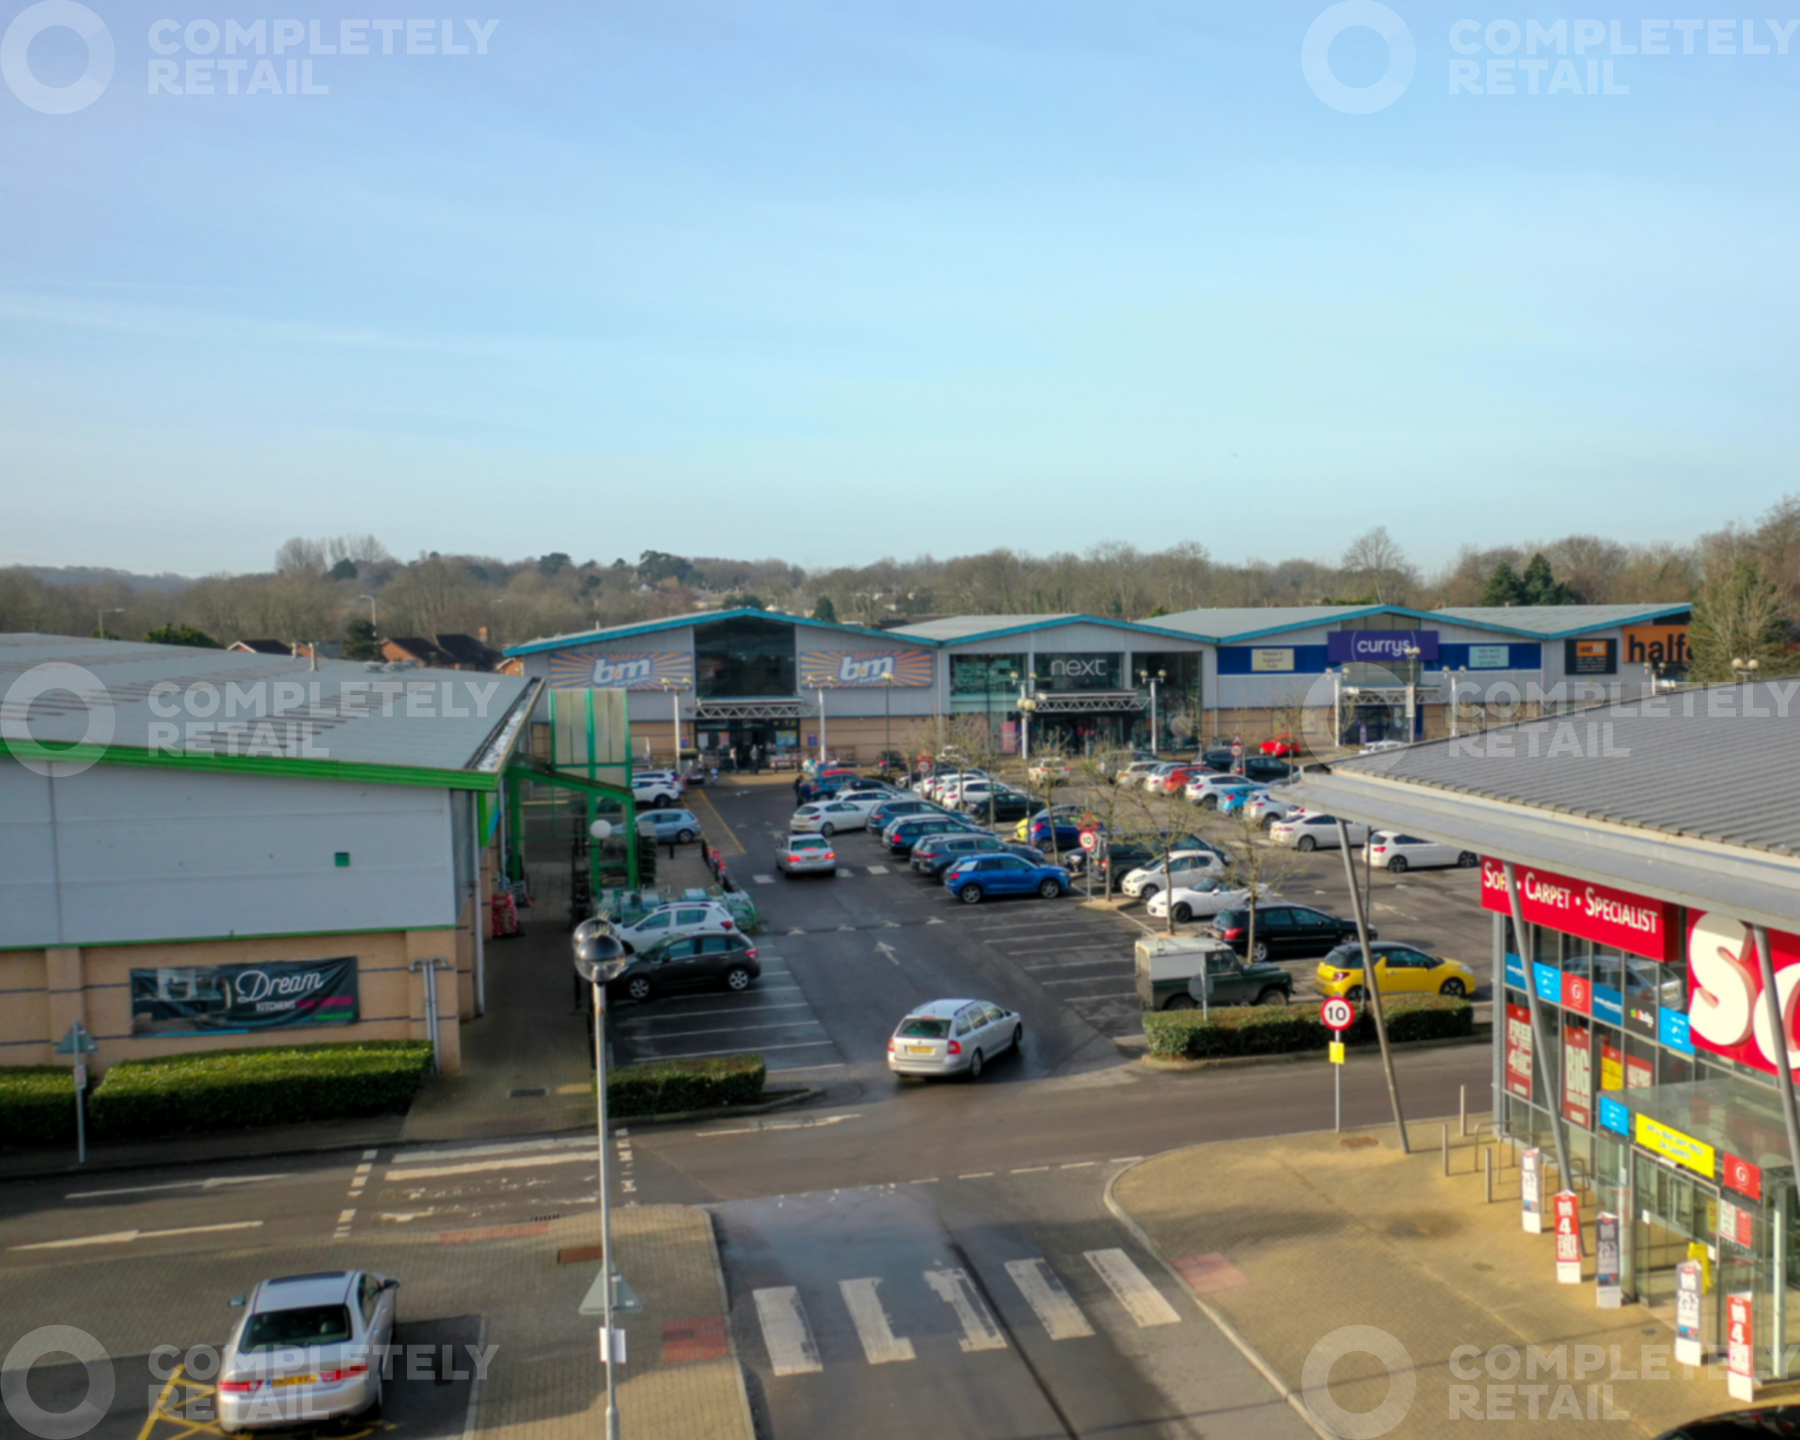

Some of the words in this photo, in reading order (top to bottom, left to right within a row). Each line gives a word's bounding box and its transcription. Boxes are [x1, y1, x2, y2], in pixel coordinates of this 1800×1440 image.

[1357, 640, 1410, 657] currys
[1051, 659, 1106, 677] next
[1525, 872, 1571, 909] CARPET
[1585, 887, 1658, 933] SPECIALIST
[235, 970, 324, 1003] Dream
[1328, 1006, 1347, 1021] 10
